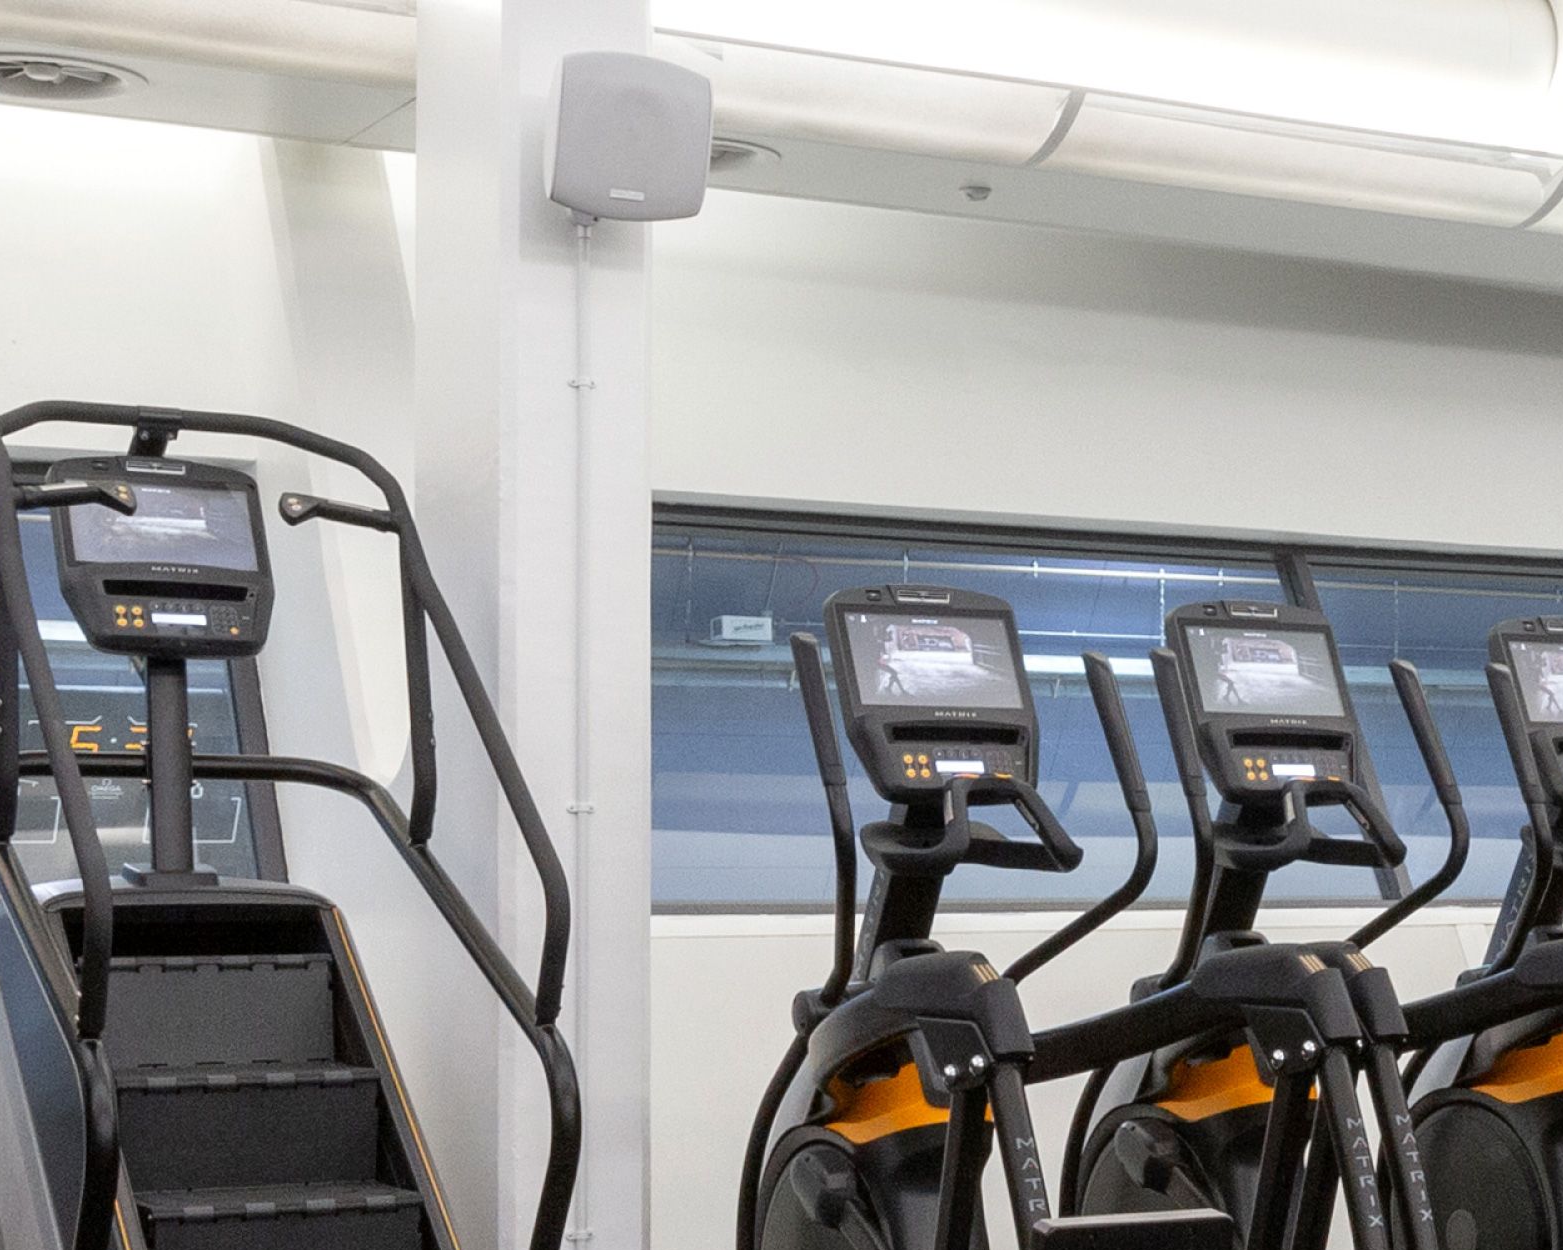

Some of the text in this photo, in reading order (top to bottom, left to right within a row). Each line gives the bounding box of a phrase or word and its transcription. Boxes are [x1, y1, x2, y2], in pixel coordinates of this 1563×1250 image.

[150, 565, 200, 574] MATRIX
[934, 710, 978, 719] MATRIX
[1269, 718, 1308, 726] MATRIX
[1015, 1136, 1047, 1212] MATR
[1347, 1117, 1385, 1228] MATRIX
[1395, 1113, 1434, 1223] MATRIX
